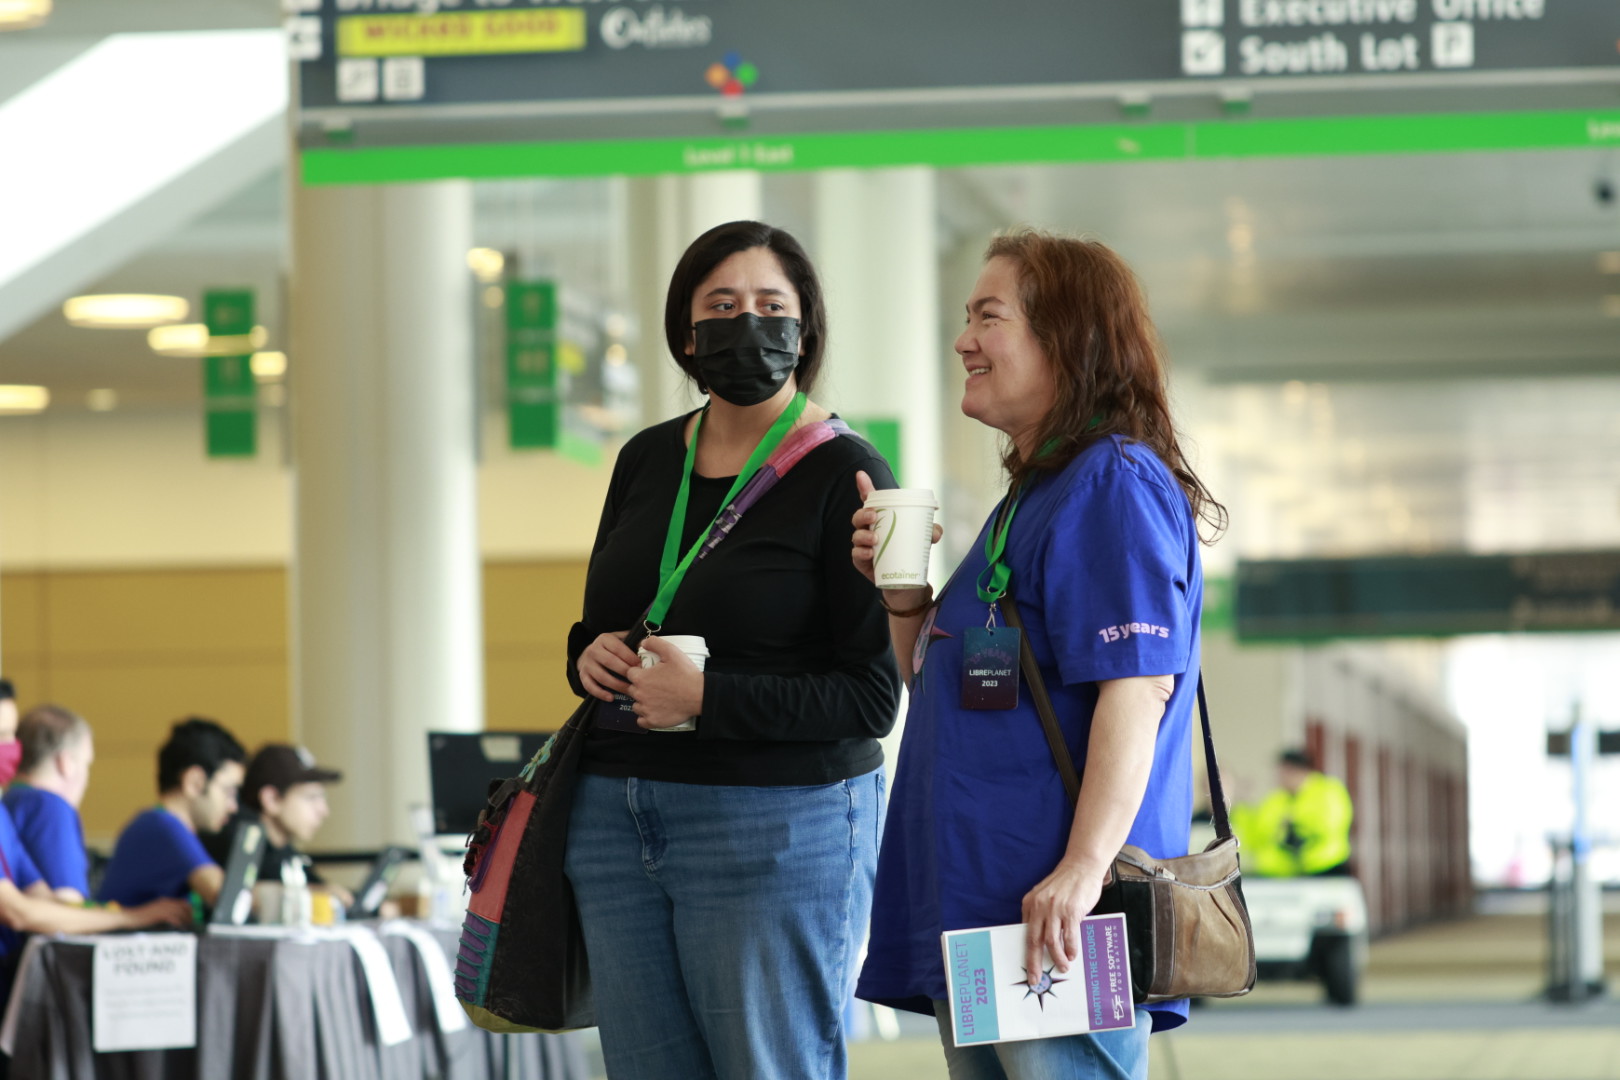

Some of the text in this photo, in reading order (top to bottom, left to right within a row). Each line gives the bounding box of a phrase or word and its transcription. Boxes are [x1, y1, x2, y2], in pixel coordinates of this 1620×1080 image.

[1240, 32, 1347, 73] South
[1360, 31, 1419, 70] Lot
[1099, 622, 1170, 643] 15 years
[102, 941, 188, 960] LOST AND
[114, 960, 177, 976] FOUND
[1104, 925, 1118, 993] FREE SOFTWARE
[955, 941, 975, 1036] LIBREPLANET
[974, 968, 988, 1005] 2023
[1086, 924, 1103, 1026] CHARTING THE COURSE
